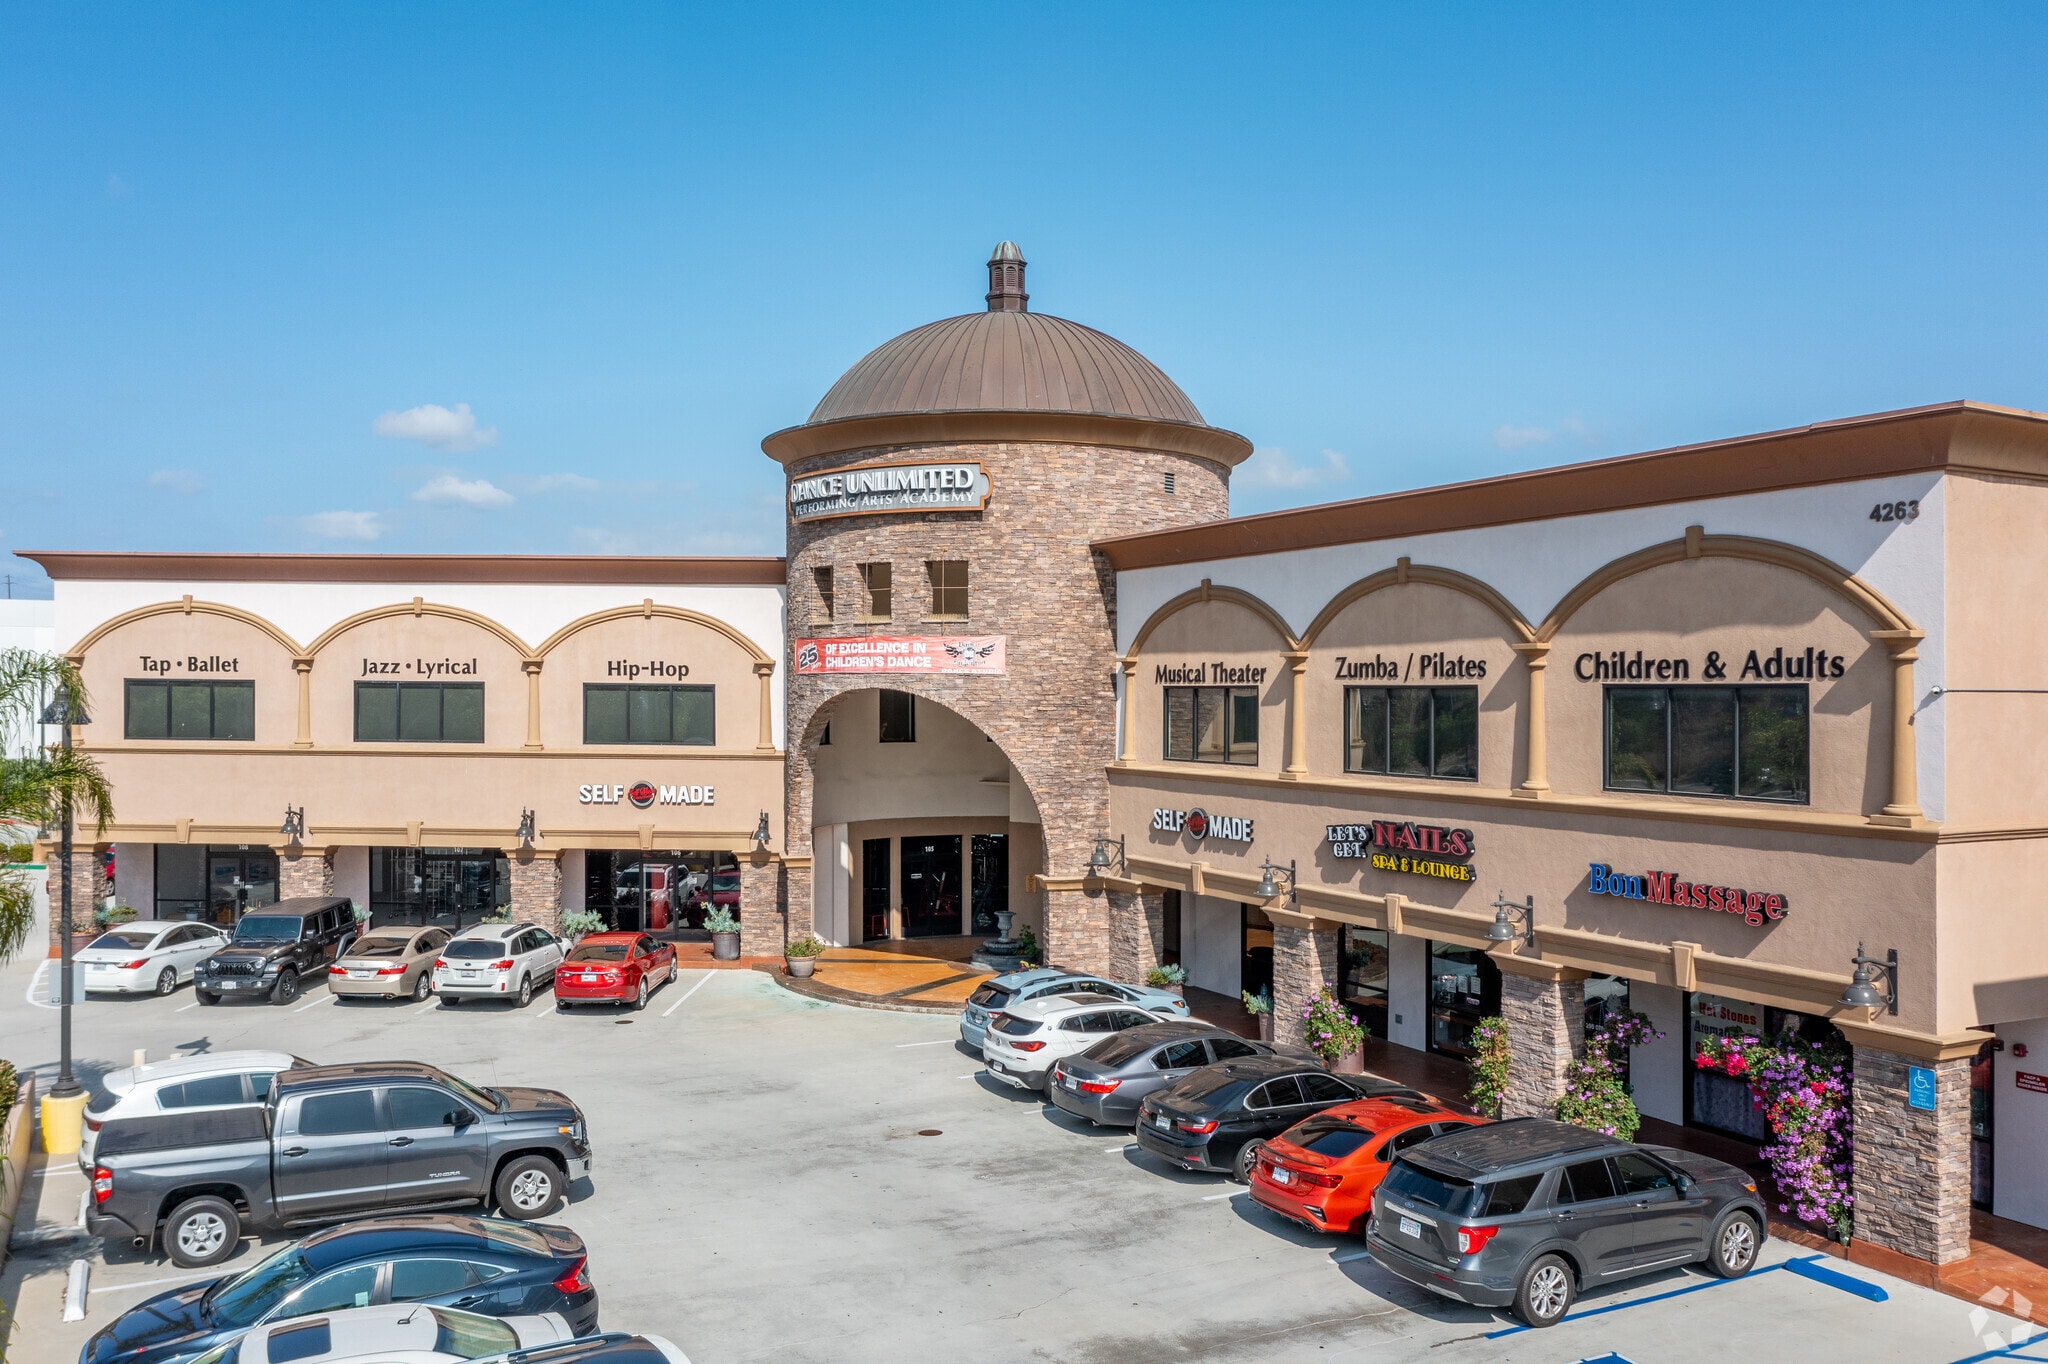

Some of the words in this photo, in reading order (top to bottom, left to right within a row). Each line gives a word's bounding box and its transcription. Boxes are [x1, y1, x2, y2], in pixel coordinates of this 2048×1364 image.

[791, 476, 842, 502] DANCE
[846, 468, 974, 494] UNLIMITED
[796, 498, 856, 516] PERFORMING
[861, 494, 893, 506] ARTS
[899, 491, 975, 504] ACADEMY
[1869, 500, 1920, 522] 4263
[799, 647, 818, 669] 25
[825, 643, 839, 655] OF
[840, 642, 909, 654] EXCELLENCE
[912, 642, 926, 653] IN
[140, 656, 171, 676] Tap
[187, 656, 239, 672] Ballet
[361, 658, 400, 676] Jazz
[417, 658, 477, 679] Lyrical
[607, 659, 690, 681] Hip-Hop
[825, 656, 884, 668] CHILDREN'S
[887, 656, 932, 667] DANCE
[1155, 662, 1206, 684] Musical
[1211, 662, 1267, 684] Theater
[1335, 654, 1398, 679] Zumba
[1420, 652, 1487, 679] Pilates
[1575, 651, 1690, 681] Children
[1703, 651, 1727, 679] &
[1740, 647, 1845, 680] Adults
[579, 784, 624, 803] SELF
[660, 785, 715, 804] MADE
[1153, 808, 1185, 832] SELF
[1209, 815, 1252, 842] MADE
[1326, 825, 1368, 841] LET'S
[1373, 822, 1468, 856] NAILS
[1333, 842, 1362, 857] GET
[1371, 854, 1397, 872] SPA
[1412, 860, 1470, 881] LOUNGE
[1720, 1007, 1757, 1026] Stones
